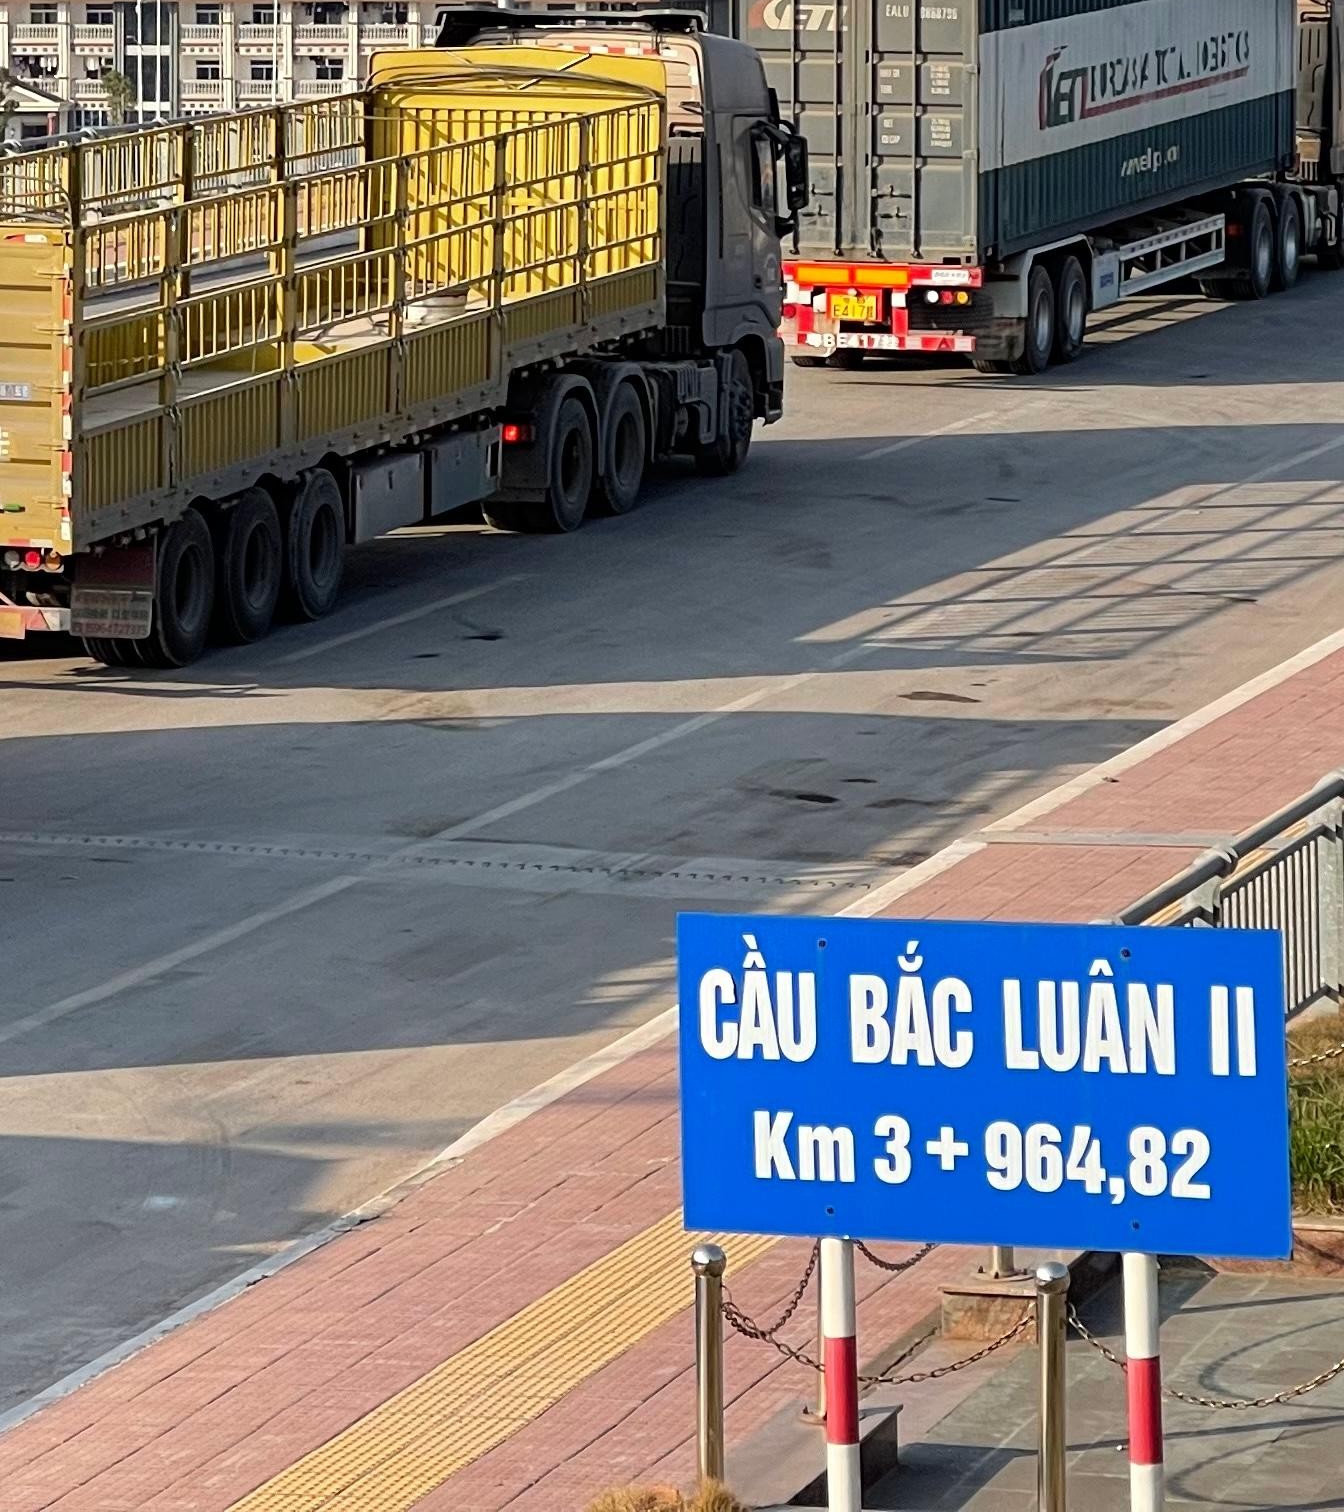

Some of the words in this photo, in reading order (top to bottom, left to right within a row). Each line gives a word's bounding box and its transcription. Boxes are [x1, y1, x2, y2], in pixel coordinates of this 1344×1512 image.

[885, 4, 910, 18] EALU
[698, 934, 817, 1063] CẦU
[849, 940, 974, 1069] BẮC
[1003, 958, 1176, 1076] LUÂN
[1210, 985, 1258, 1077] II
[753, 1110, 856, 1183] Km
[873, 1114, 913, 1185] 3
[985, 1120, 1211, 1205] 964,82
